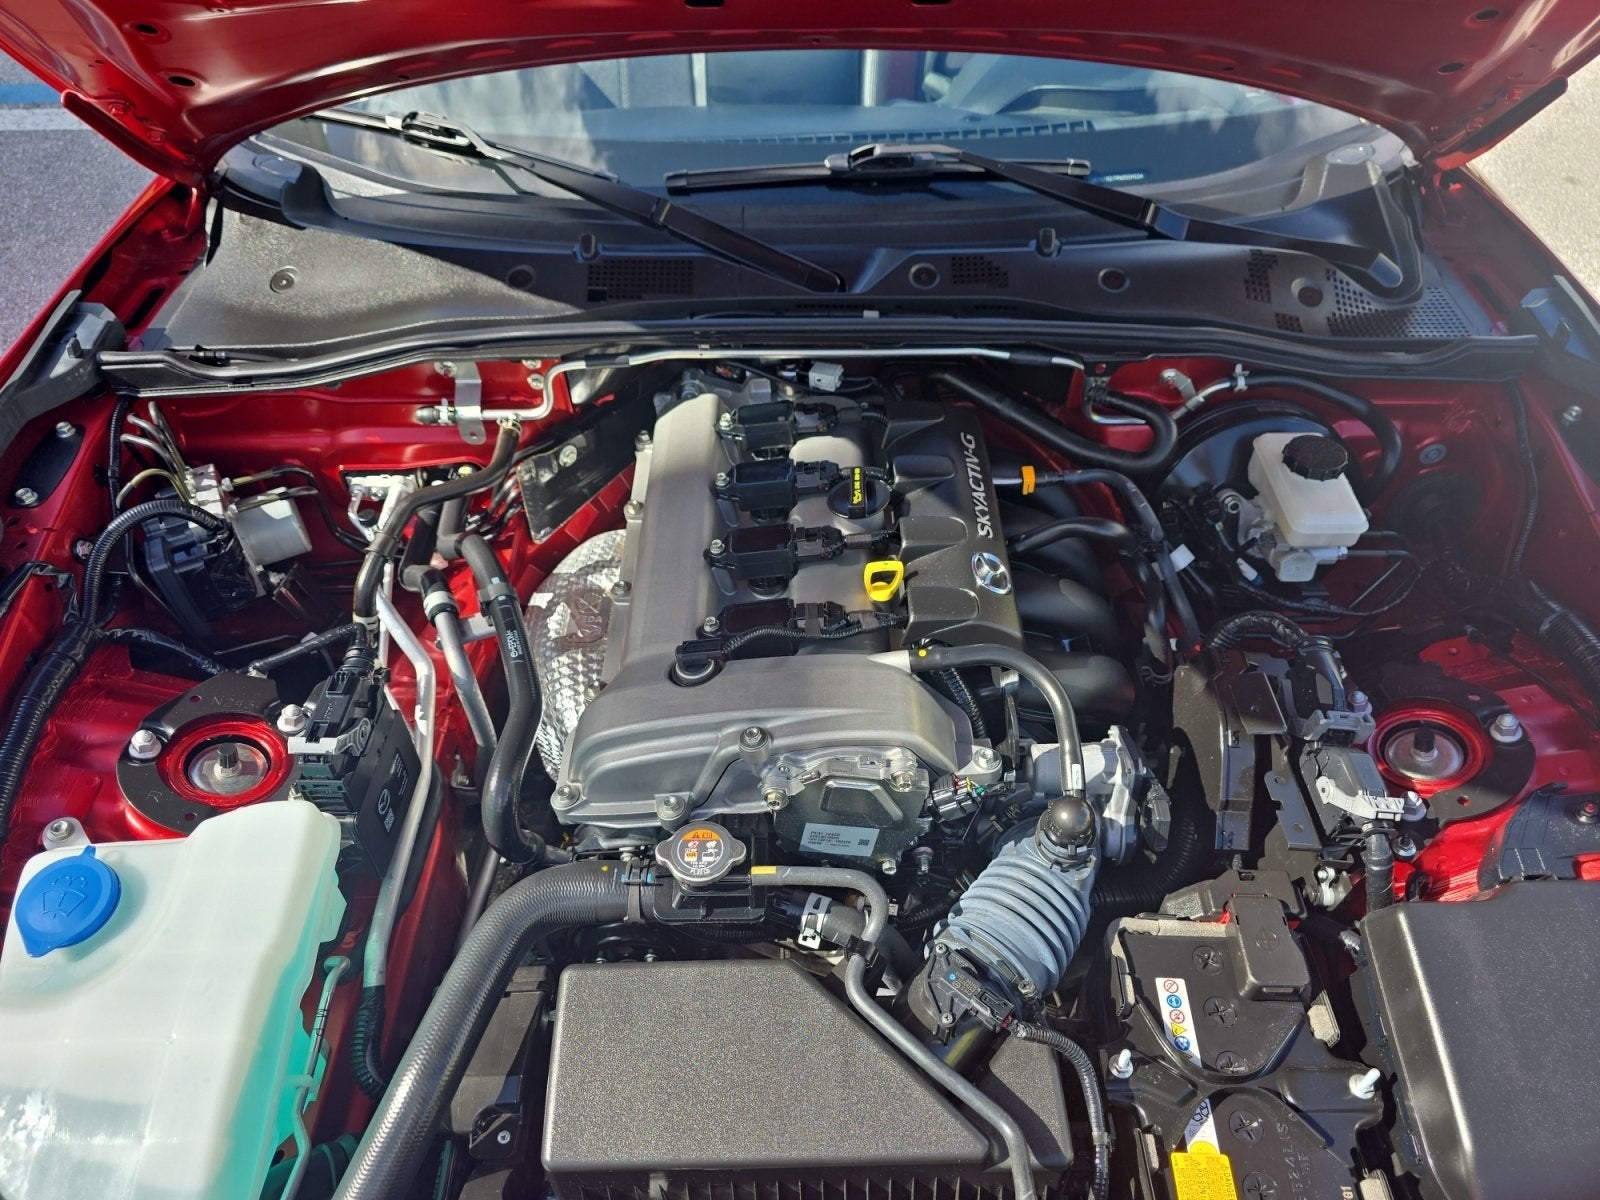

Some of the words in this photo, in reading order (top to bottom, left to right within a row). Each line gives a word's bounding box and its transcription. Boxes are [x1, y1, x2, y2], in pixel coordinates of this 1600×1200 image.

[960, 431, 994, 539] SKYACTIV-G
[1195, 1168, 1207, 1195] POISON
[1223, 1171, 1237, 1200] DANGE
